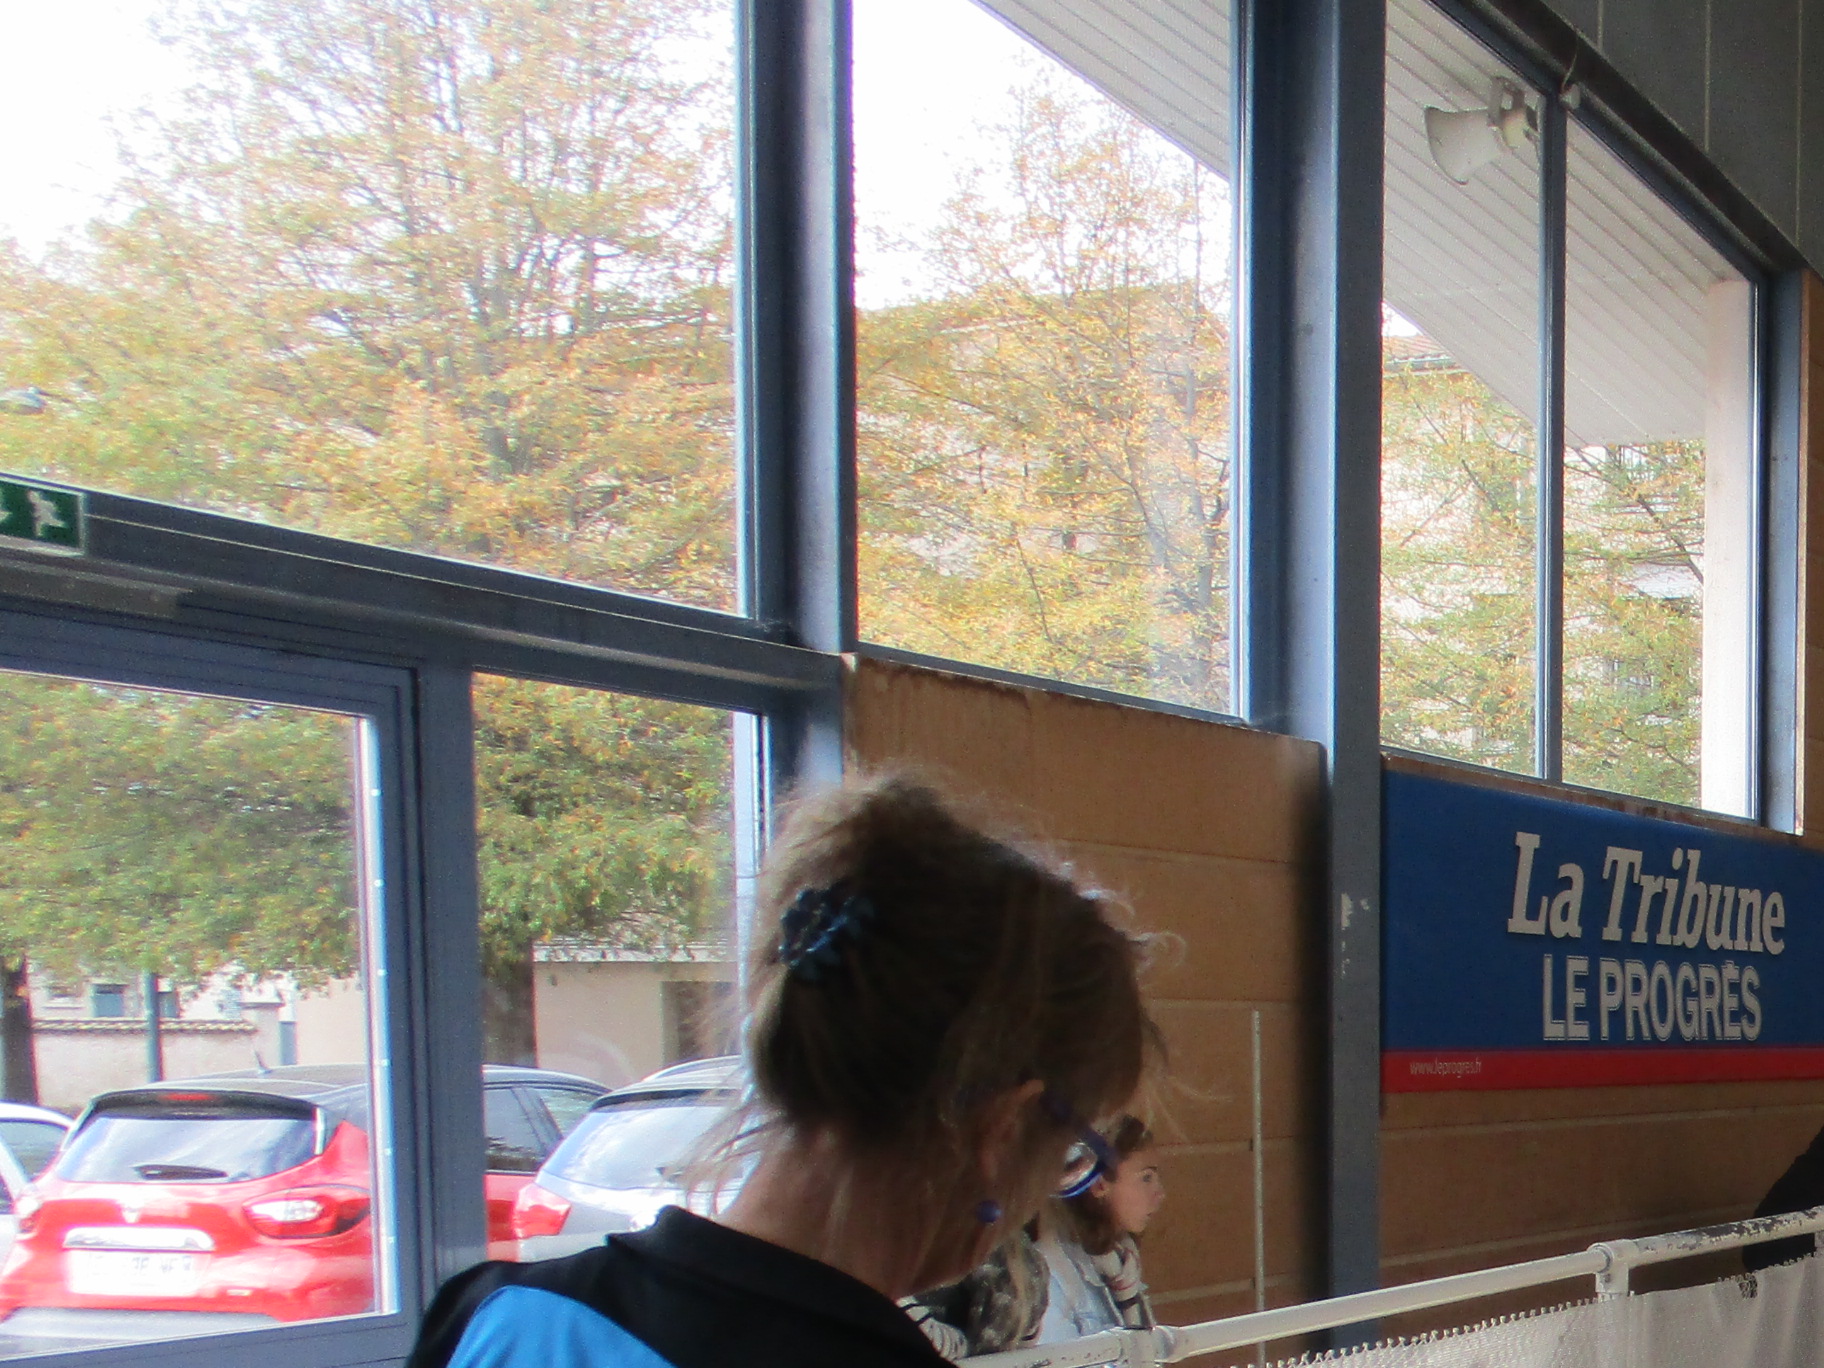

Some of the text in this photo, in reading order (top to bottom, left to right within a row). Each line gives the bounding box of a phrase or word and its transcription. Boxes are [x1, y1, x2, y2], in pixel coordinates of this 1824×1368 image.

[1507, 831, 1785, 955] La Tribune
[1543, 954, 1762, 1042] LE PROGRÈS
